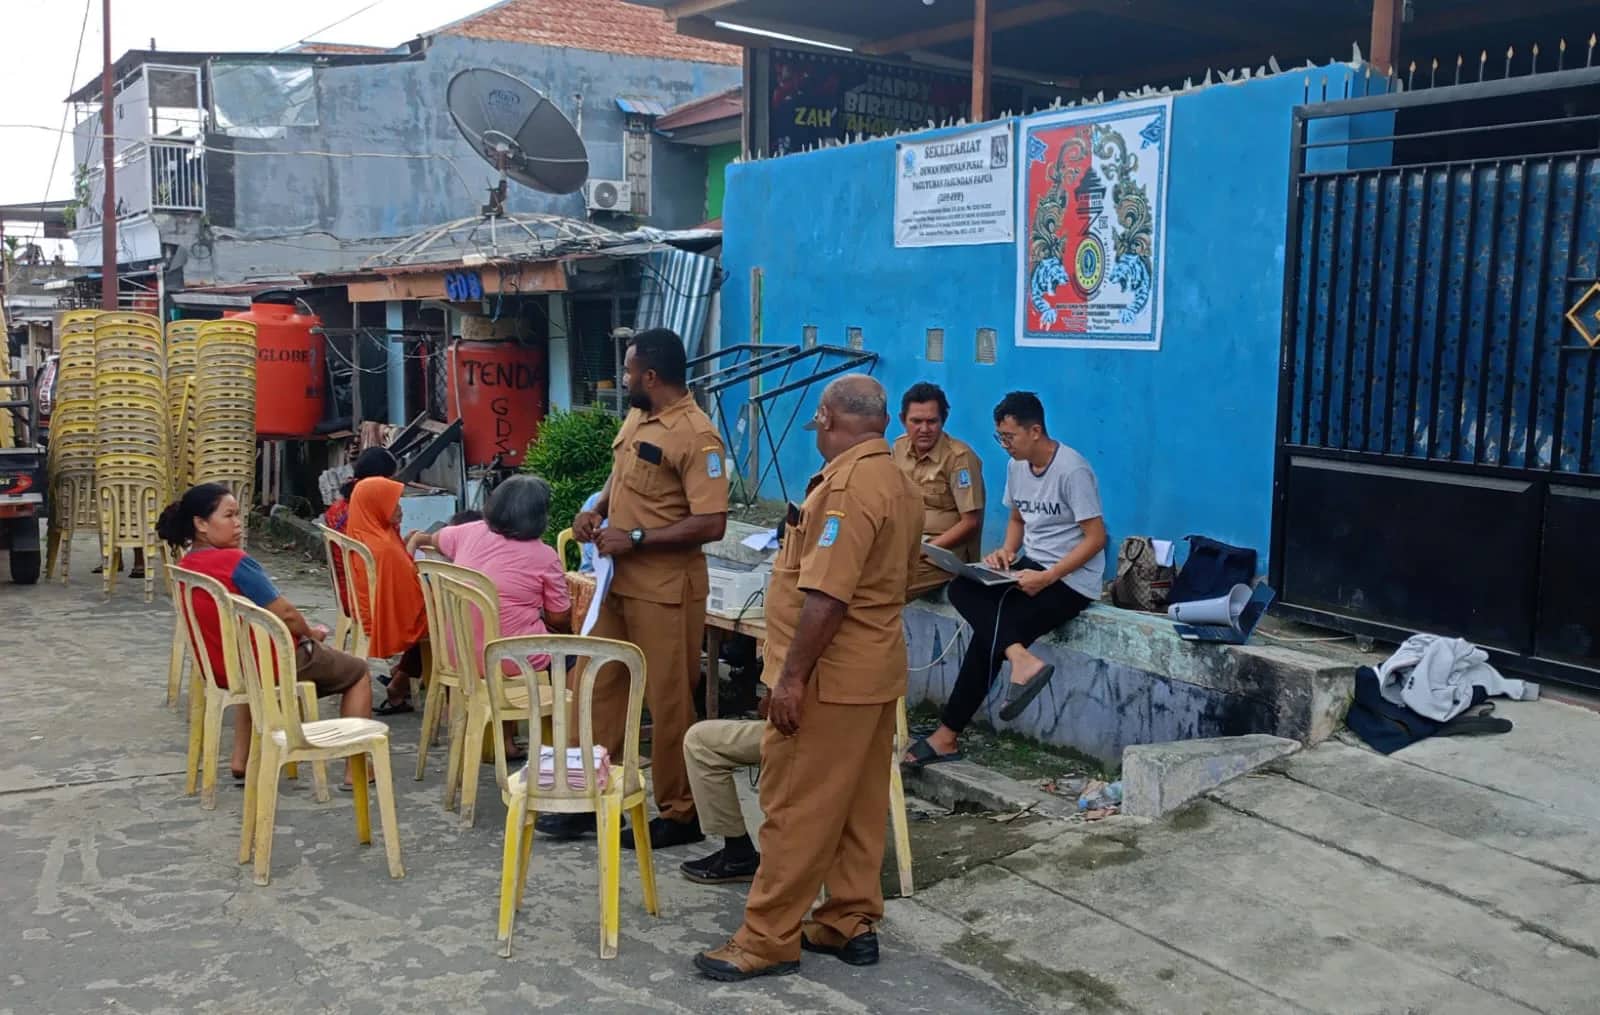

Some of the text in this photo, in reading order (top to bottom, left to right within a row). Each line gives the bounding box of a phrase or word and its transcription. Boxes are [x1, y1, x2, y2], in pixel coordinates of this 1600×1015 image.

[868, 75, 930, 99] HAPPY
[844, 92, 946, 123] BIRTHDAY
[924, 140, 982, 159] SEKRETARIAT
[973, 173, 993, 184] PAPUA
[258, 348, 309, 362] GLOBE
